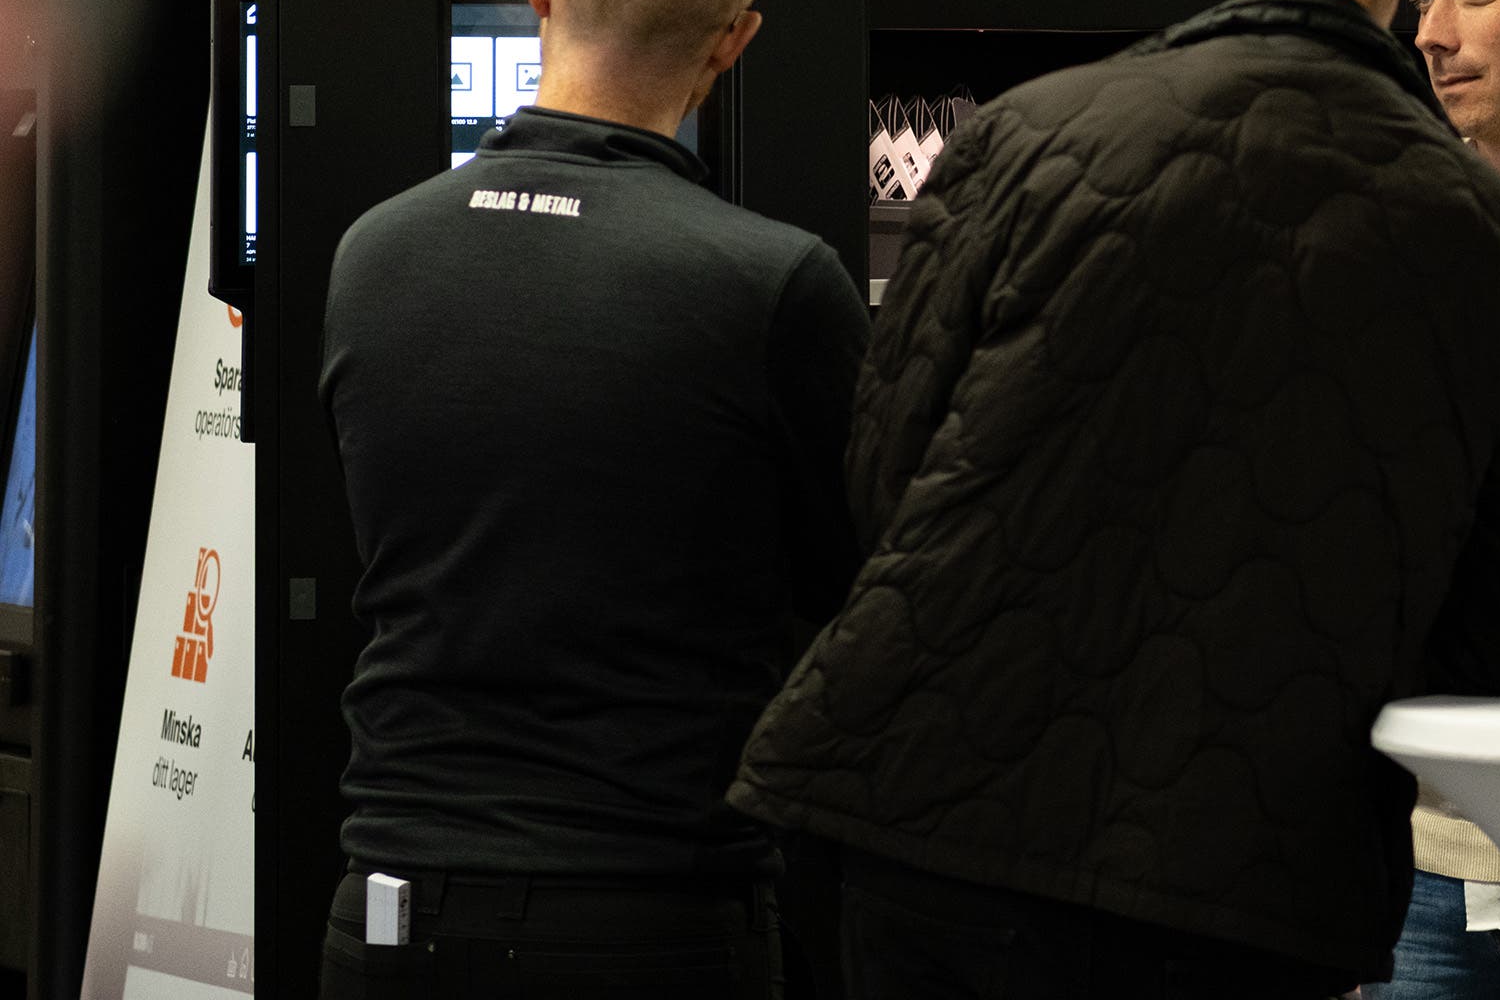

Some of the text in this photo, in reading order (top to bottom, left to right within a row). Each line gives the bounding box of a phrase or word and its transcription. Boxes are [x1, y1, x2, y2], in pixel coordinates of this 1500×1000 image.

[469, 190, 581, 217] BESLAG & METALL
[161, 708, 202, 749] Minska
[152, 756, 198, 801] ditt lager
